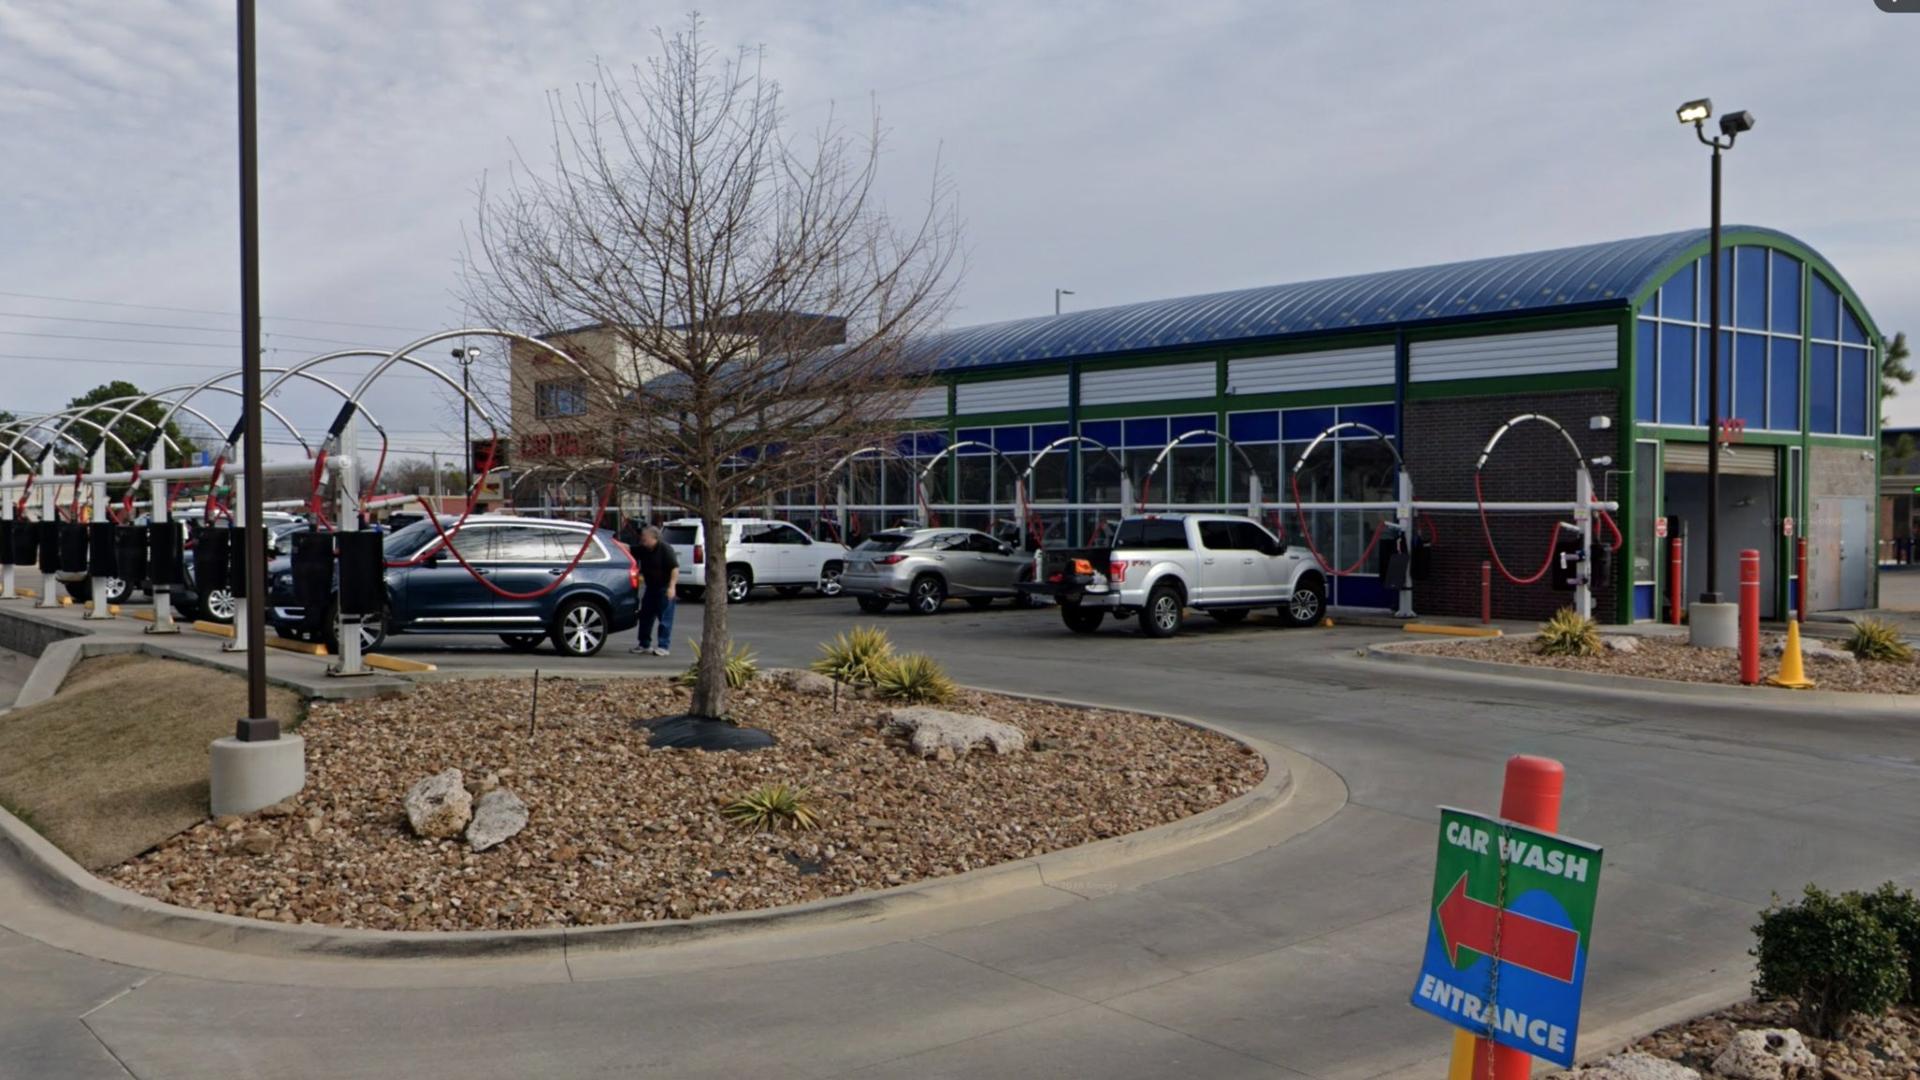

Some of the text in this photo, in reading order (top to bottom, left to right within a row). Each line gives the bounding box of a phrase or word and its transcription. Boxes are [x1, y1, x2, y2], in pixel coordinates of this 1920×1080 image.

[1446, 821, 1589, 882] CAR WASH
[1419, 973, 1567, 1053] ENTRANCE
